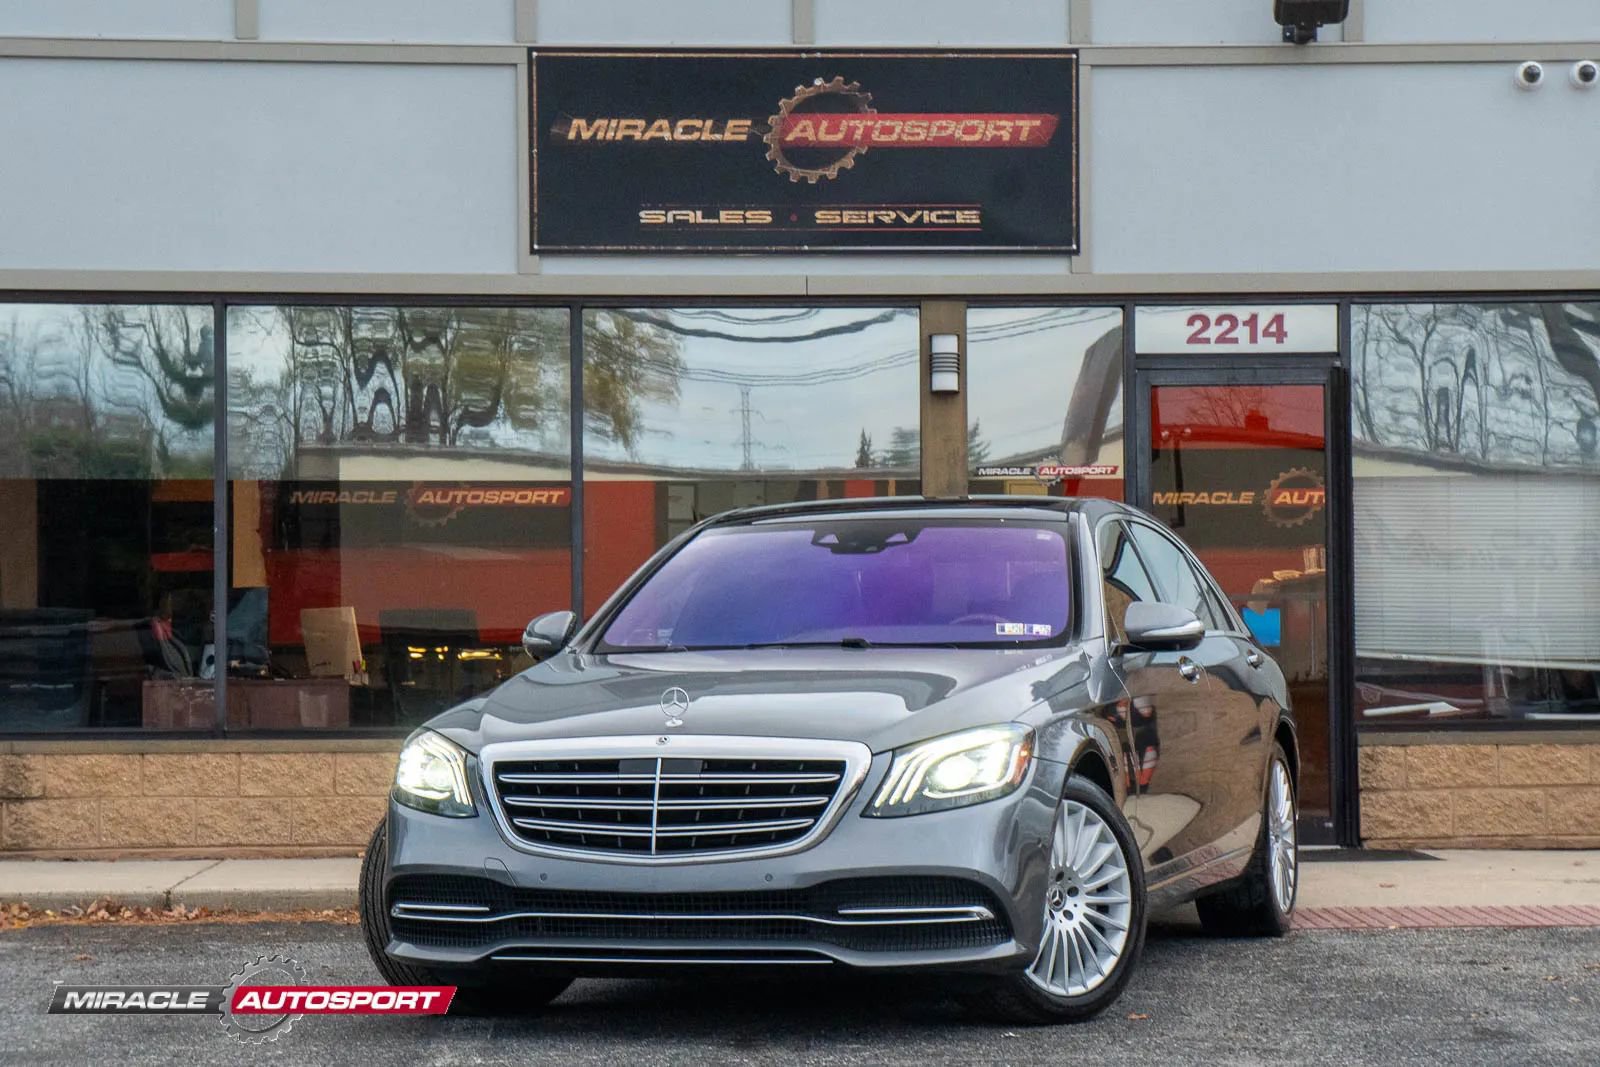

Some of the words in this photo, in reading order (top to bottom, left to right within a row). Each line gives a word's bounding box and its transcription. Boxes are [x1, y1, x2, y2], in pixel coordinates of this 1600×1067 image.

[567, 118, 752, 141] MIRACLE
[784, 118, 1042, 142] AUTOSPORT
[639, 209, 773, 224] SALES
[814, 209, 982, 224] SERVICE
[1185, 312, 1288, 345] 2214
[978, 467, 1032, 476] MIRACLE
[1040, 466, 1115, 475] AUTOSPORT
[289, 490, 398, 504] MIRACLE
[417, 490, 565, 504] AUTOSPORT
[1152, 491, 1255, 505] MIRACLE
[1274, 490, 1326, 505] AUT
